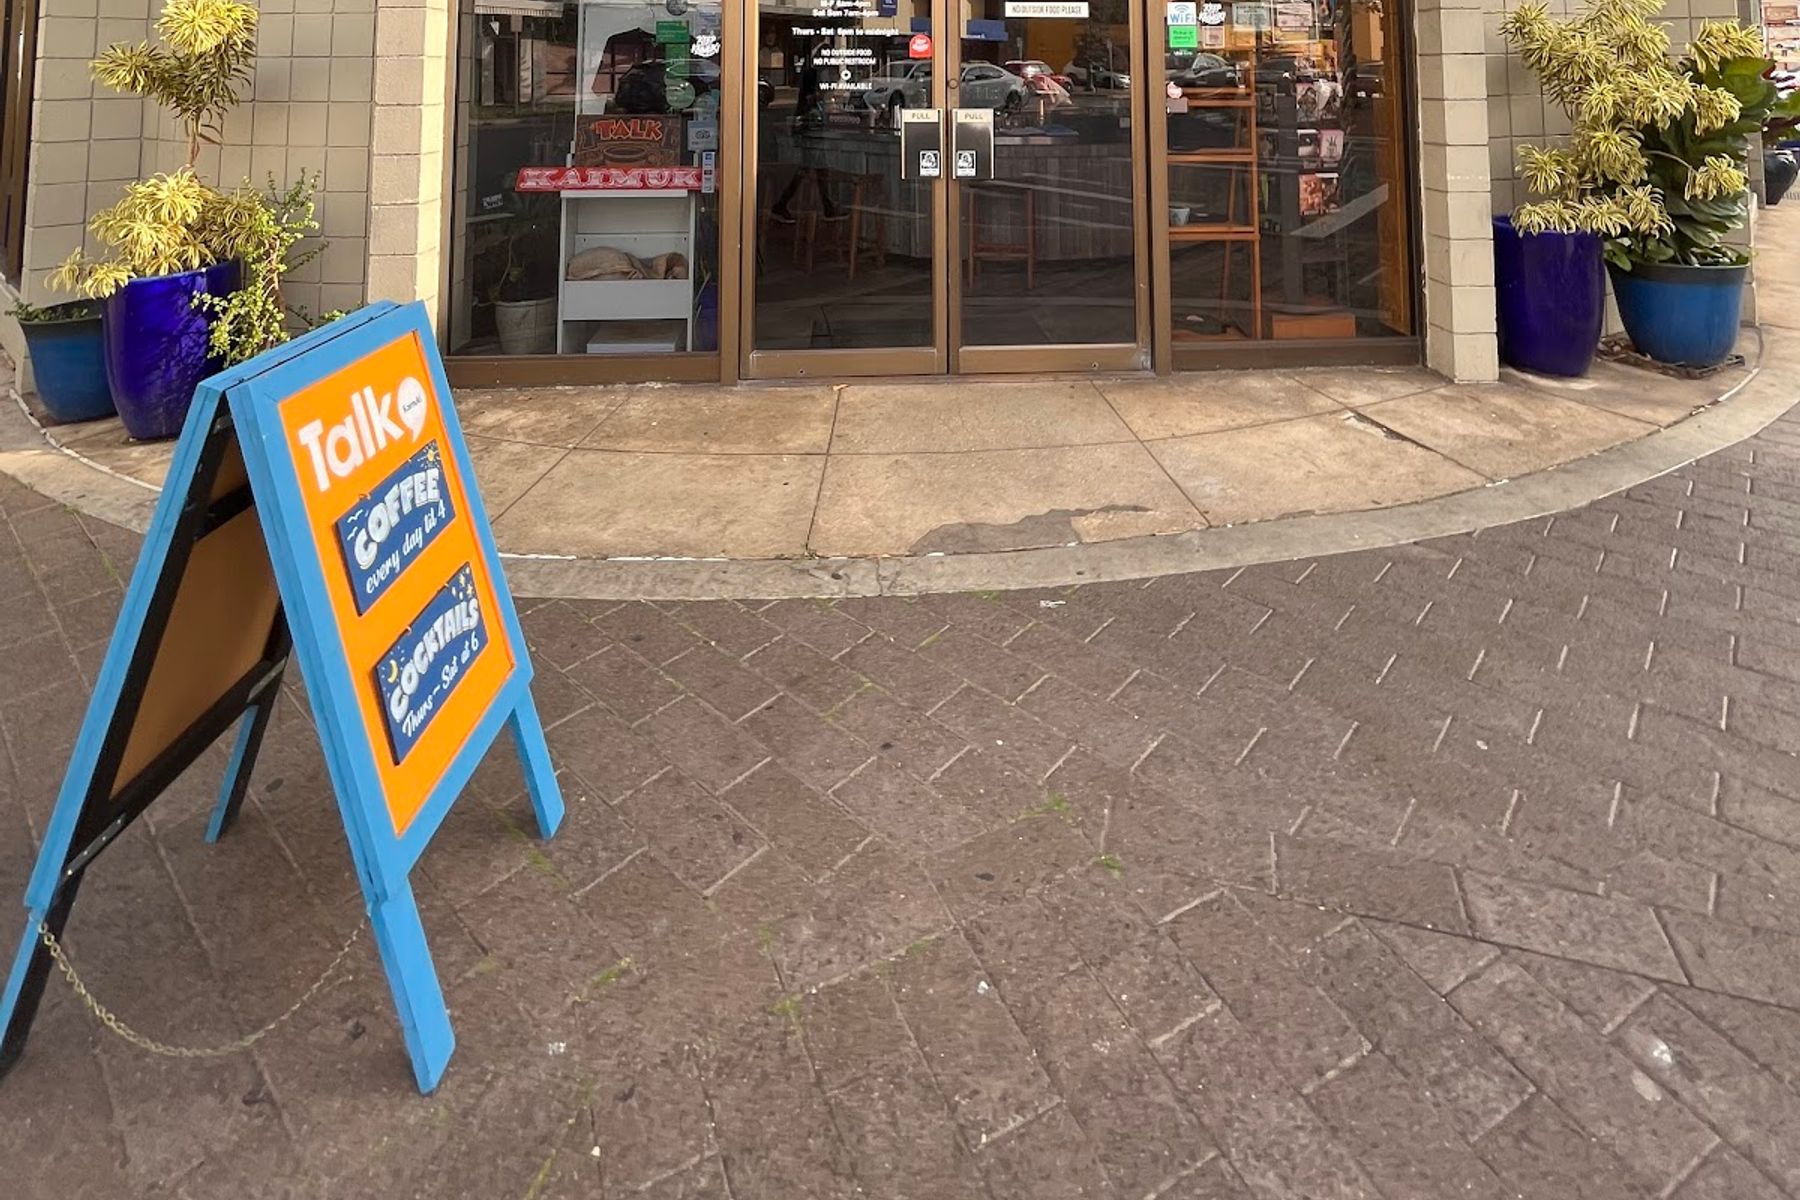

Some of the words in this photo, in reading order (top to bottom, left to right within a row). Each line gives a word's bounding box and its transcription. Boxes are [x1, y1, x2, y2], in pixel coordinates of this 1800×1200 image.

[1062, 5, 1081, 14] PLEASE
[791, 27, 815, 35] Thurs
[821, 27, 834, 35] Sat
[865, 27, 899, 37] midnight
[912, 112, 931, 120] PULL
[964, 112, 983, 120] PULL
[595, 119, 663, 141] TALK
[519, 168, 714, 189] KAIMUK
[298, 385, 405, 493] Talk
[354, 467, 440, 569] COFFEE
[366, 550, 400, 594] every
[402, 527, 423, 555] day
[438, 499, 446, 518] 4
[390, 598, 479, 723] COCKTAILS
[402, 694, 433, 738] Thurs
[441, 655, 459, 689] Sat
[461, 640, 470, 664] at
[471, 630, 479, 651] 6
